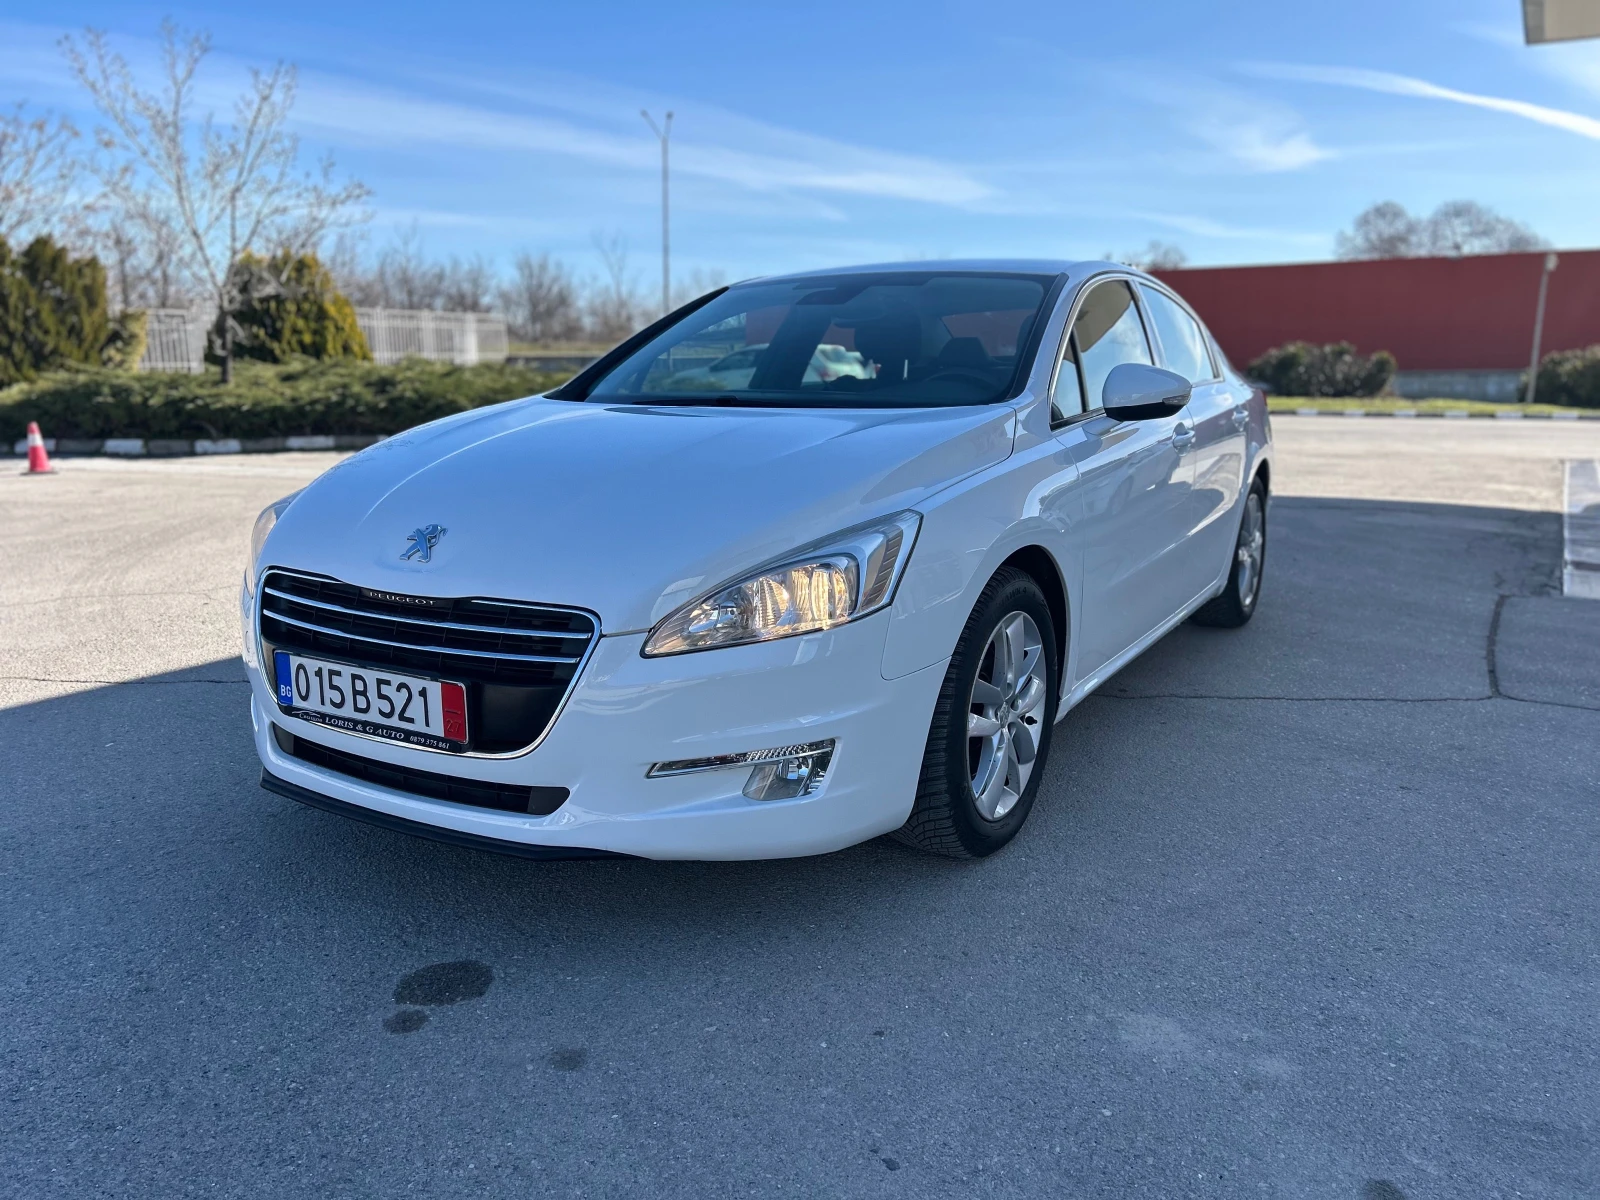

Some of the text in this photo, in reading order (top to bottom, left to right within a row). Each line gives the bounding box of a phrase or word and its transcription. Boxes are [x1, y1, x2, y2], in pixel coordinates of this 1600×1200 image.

[370, 591, 436, 606] PEUGEOT
[280, 684, 292, 698] BG
[325, 717, 353, 729] LORIS
[356, 723, 364, 731] &
[366, 725, 374, 733] G
[375, 728, 404, 739] AUTO
[425, 739, 437, 747] 375
